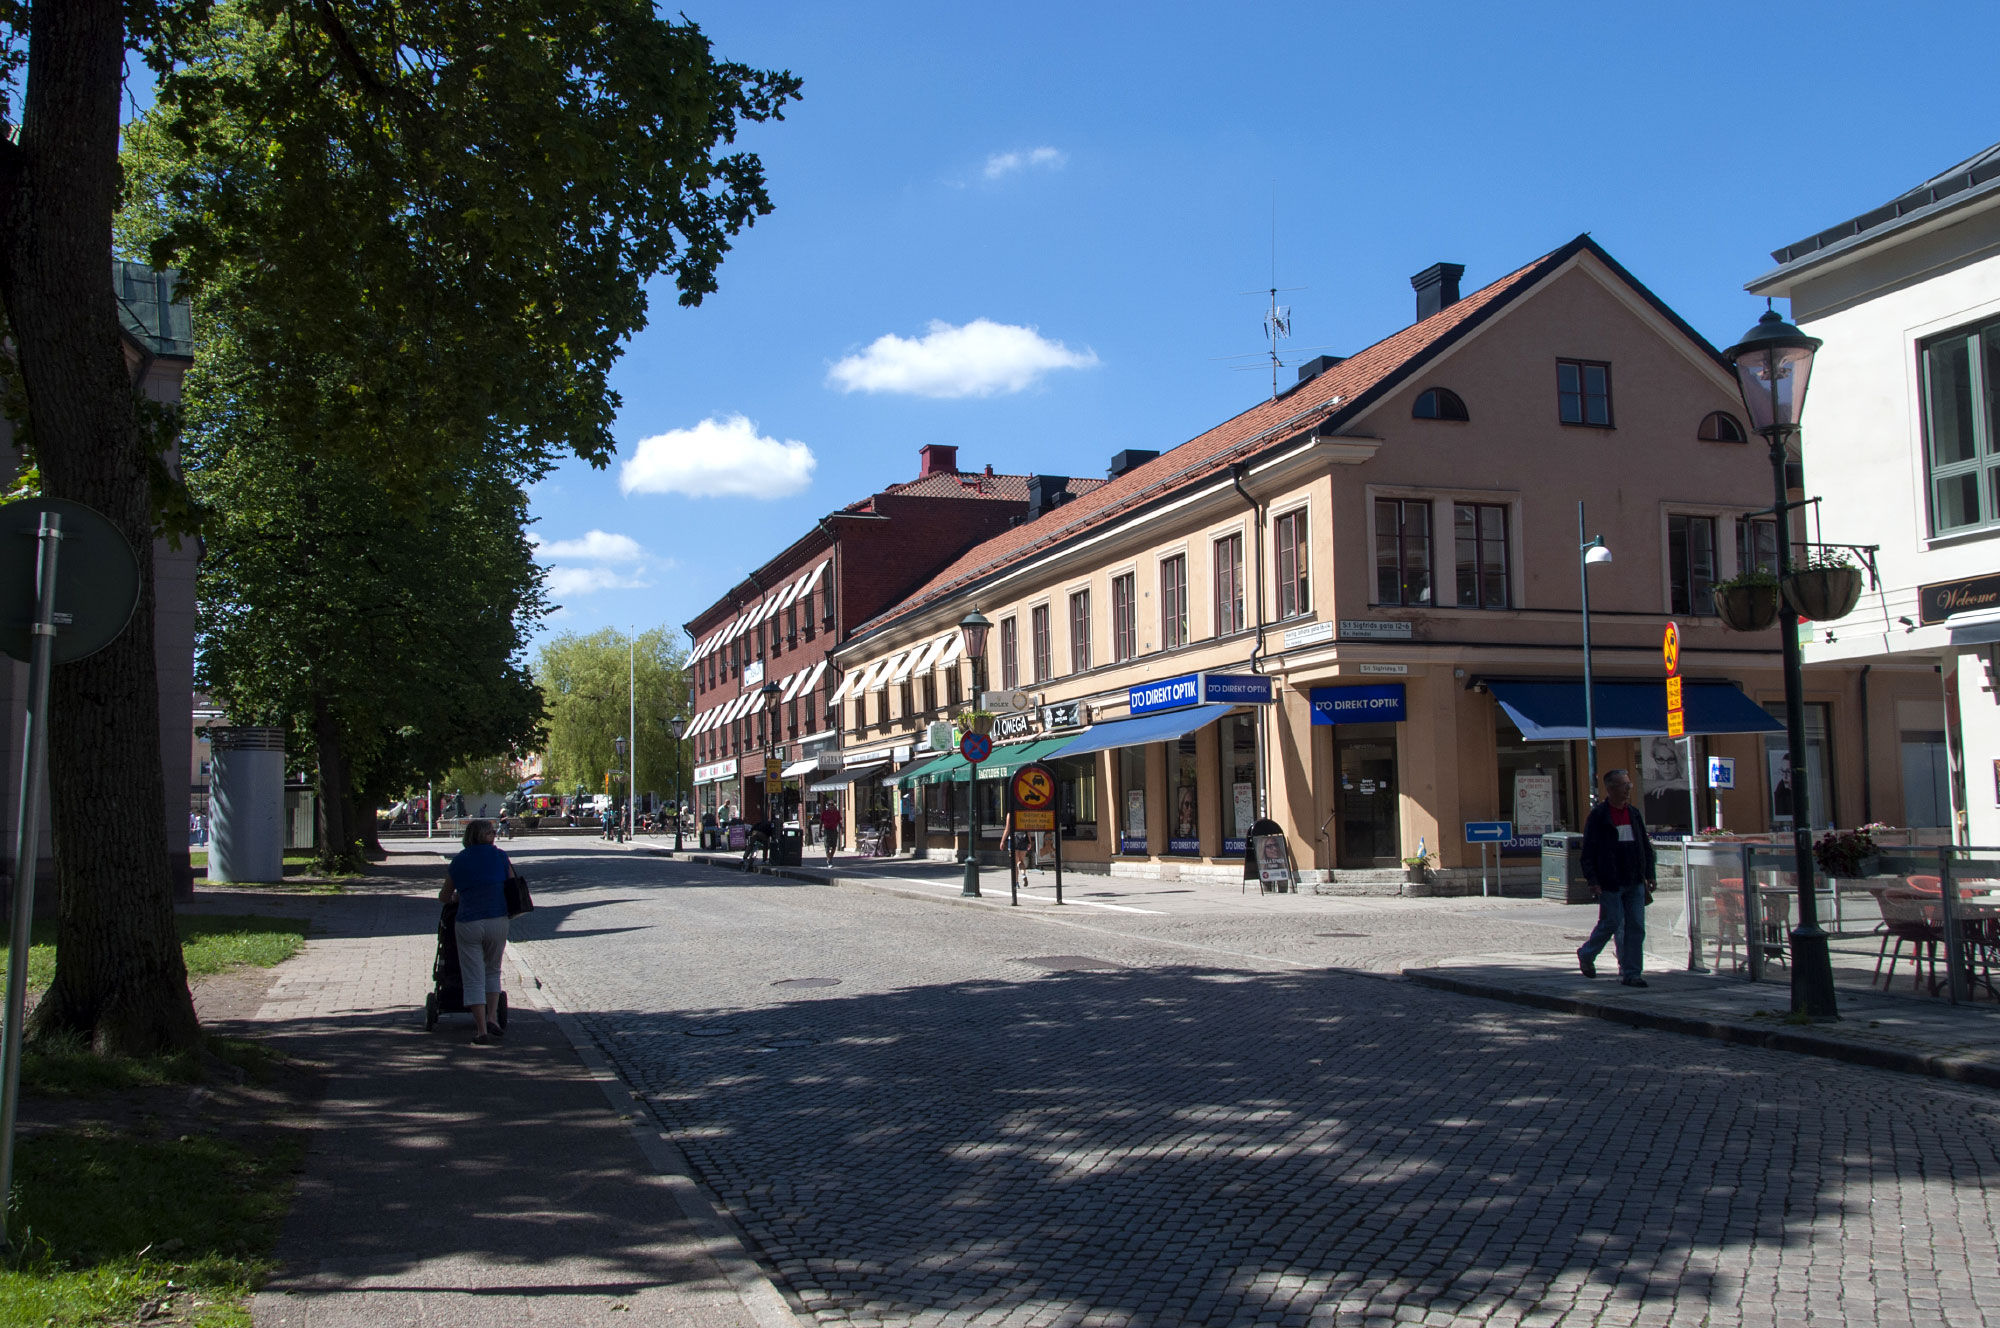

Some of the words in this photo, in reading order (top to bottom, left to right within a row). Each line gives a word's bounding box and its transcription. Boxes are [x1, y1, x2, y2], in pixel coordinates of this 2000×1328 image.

[1937, 583, 1998, 609] Welcome
[1352, 622, 1377, 630] Sigfrids
[1146, 685, 1172, 705] DIREKT
[1172, 681, 1196, 700] OPTIK
[1222, 684, 1246, 693] DIREKT
[1247, 685, 1267, 693] OPTIK
[1334, 699, 1368, 710] DIREKT
[1369, 698, 1399, 708] OPTIK
[1001, 716, 1027, 735] OMEGA
